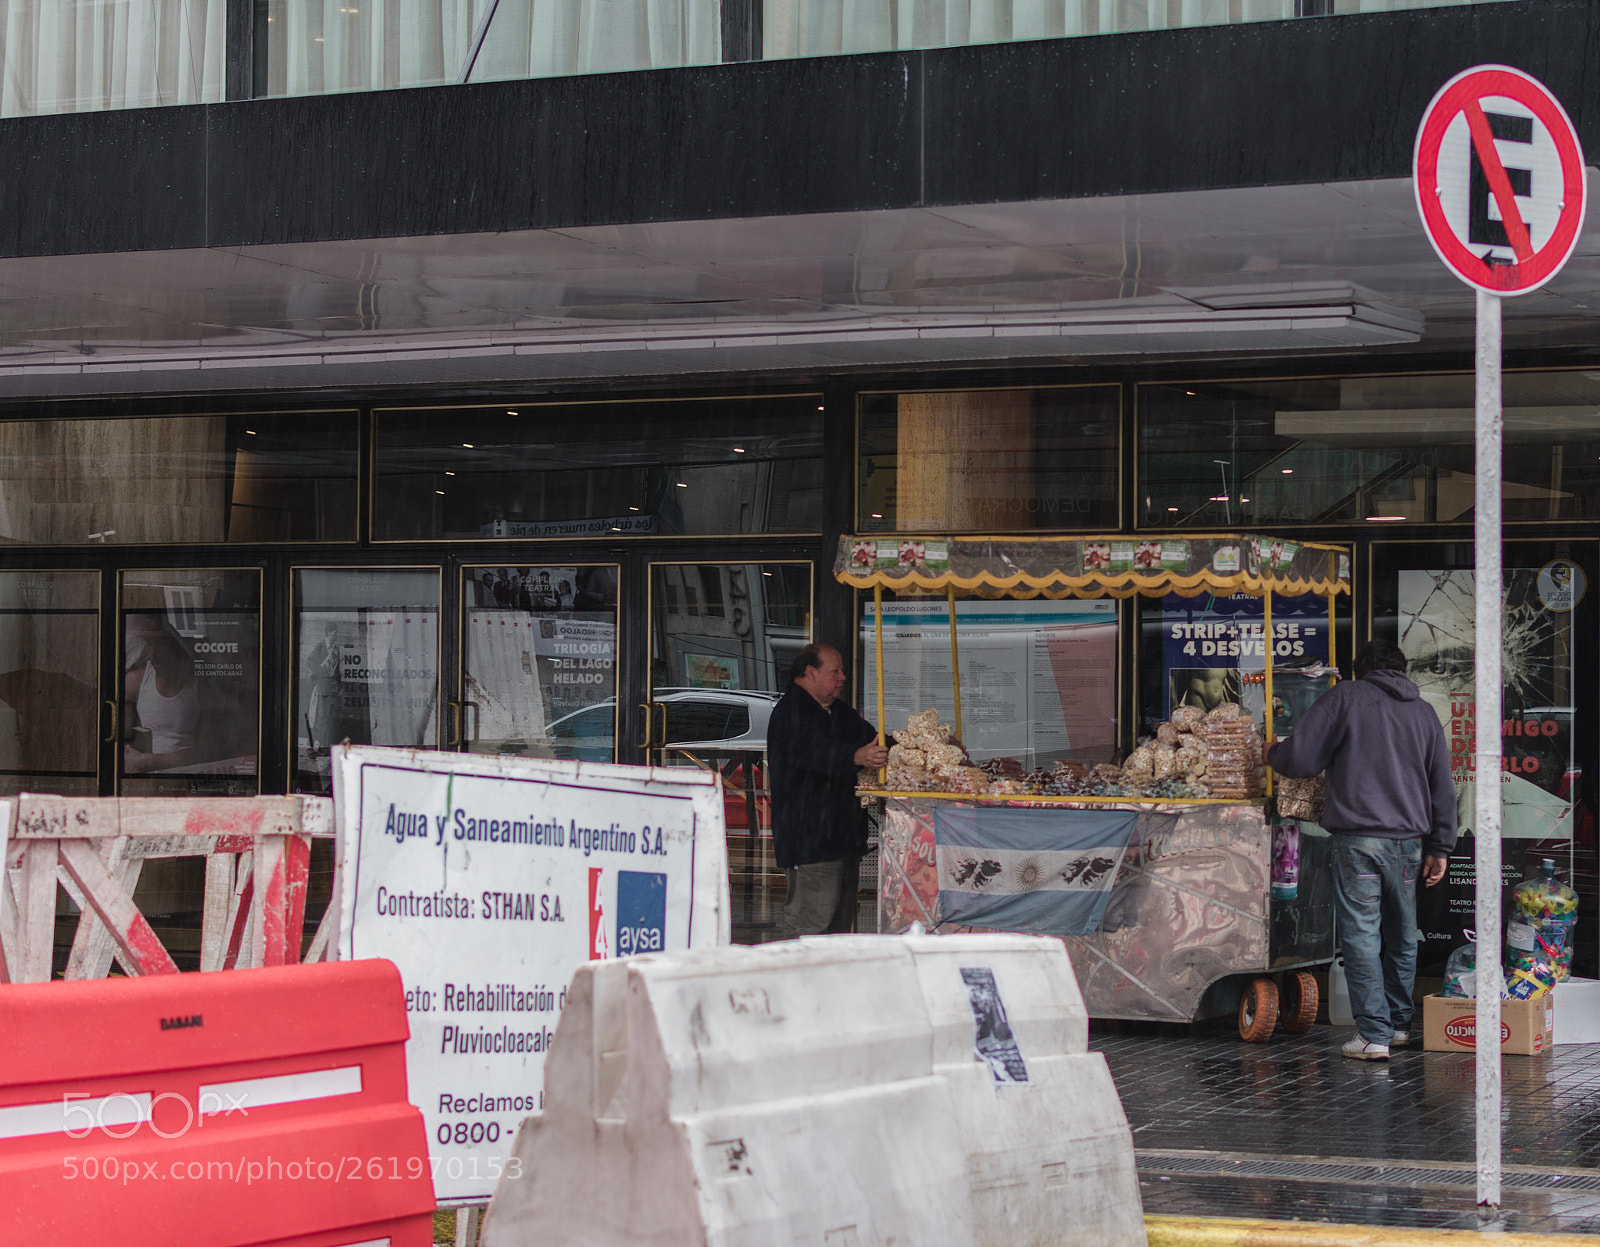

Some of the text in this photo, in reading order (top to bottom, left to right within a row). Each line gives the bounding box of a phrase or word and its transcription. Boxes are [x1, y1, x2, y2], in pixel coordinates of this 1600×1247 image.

[1469, 111, 1533, 248] E
[193, 642, 239, 653] COCOTE
[553, 641, 611, 654] TRILOGÍA
[1182, 641, 1197, 656] 4
[344, 654, 362, 665] NO
[553, 659, 612, 669] DEL LAGO
[553, 673, 604, 684] HELADO
[1451, 720, 1559, 737] ENMIGO
[1451, 756, 1540, 773] PUBLO
[385, 802, 668, 857] Agua y Saneamiento Argentino S.A.
[377, 885, 565, 922] Contratista: STHAN S.A.
[619, 926, 661, 952] aysa
[1427, 932, 1452, 940] Cultura
[405, 985, 437, 1012] eto:
[443, 983, 555, 1012] Rehabilitación
[441, 1024, 555, 1054] Pluviocloacale
[438, 1092, 535, 1114] Reclamos
[437, 1120, 501, 1145] 0800
